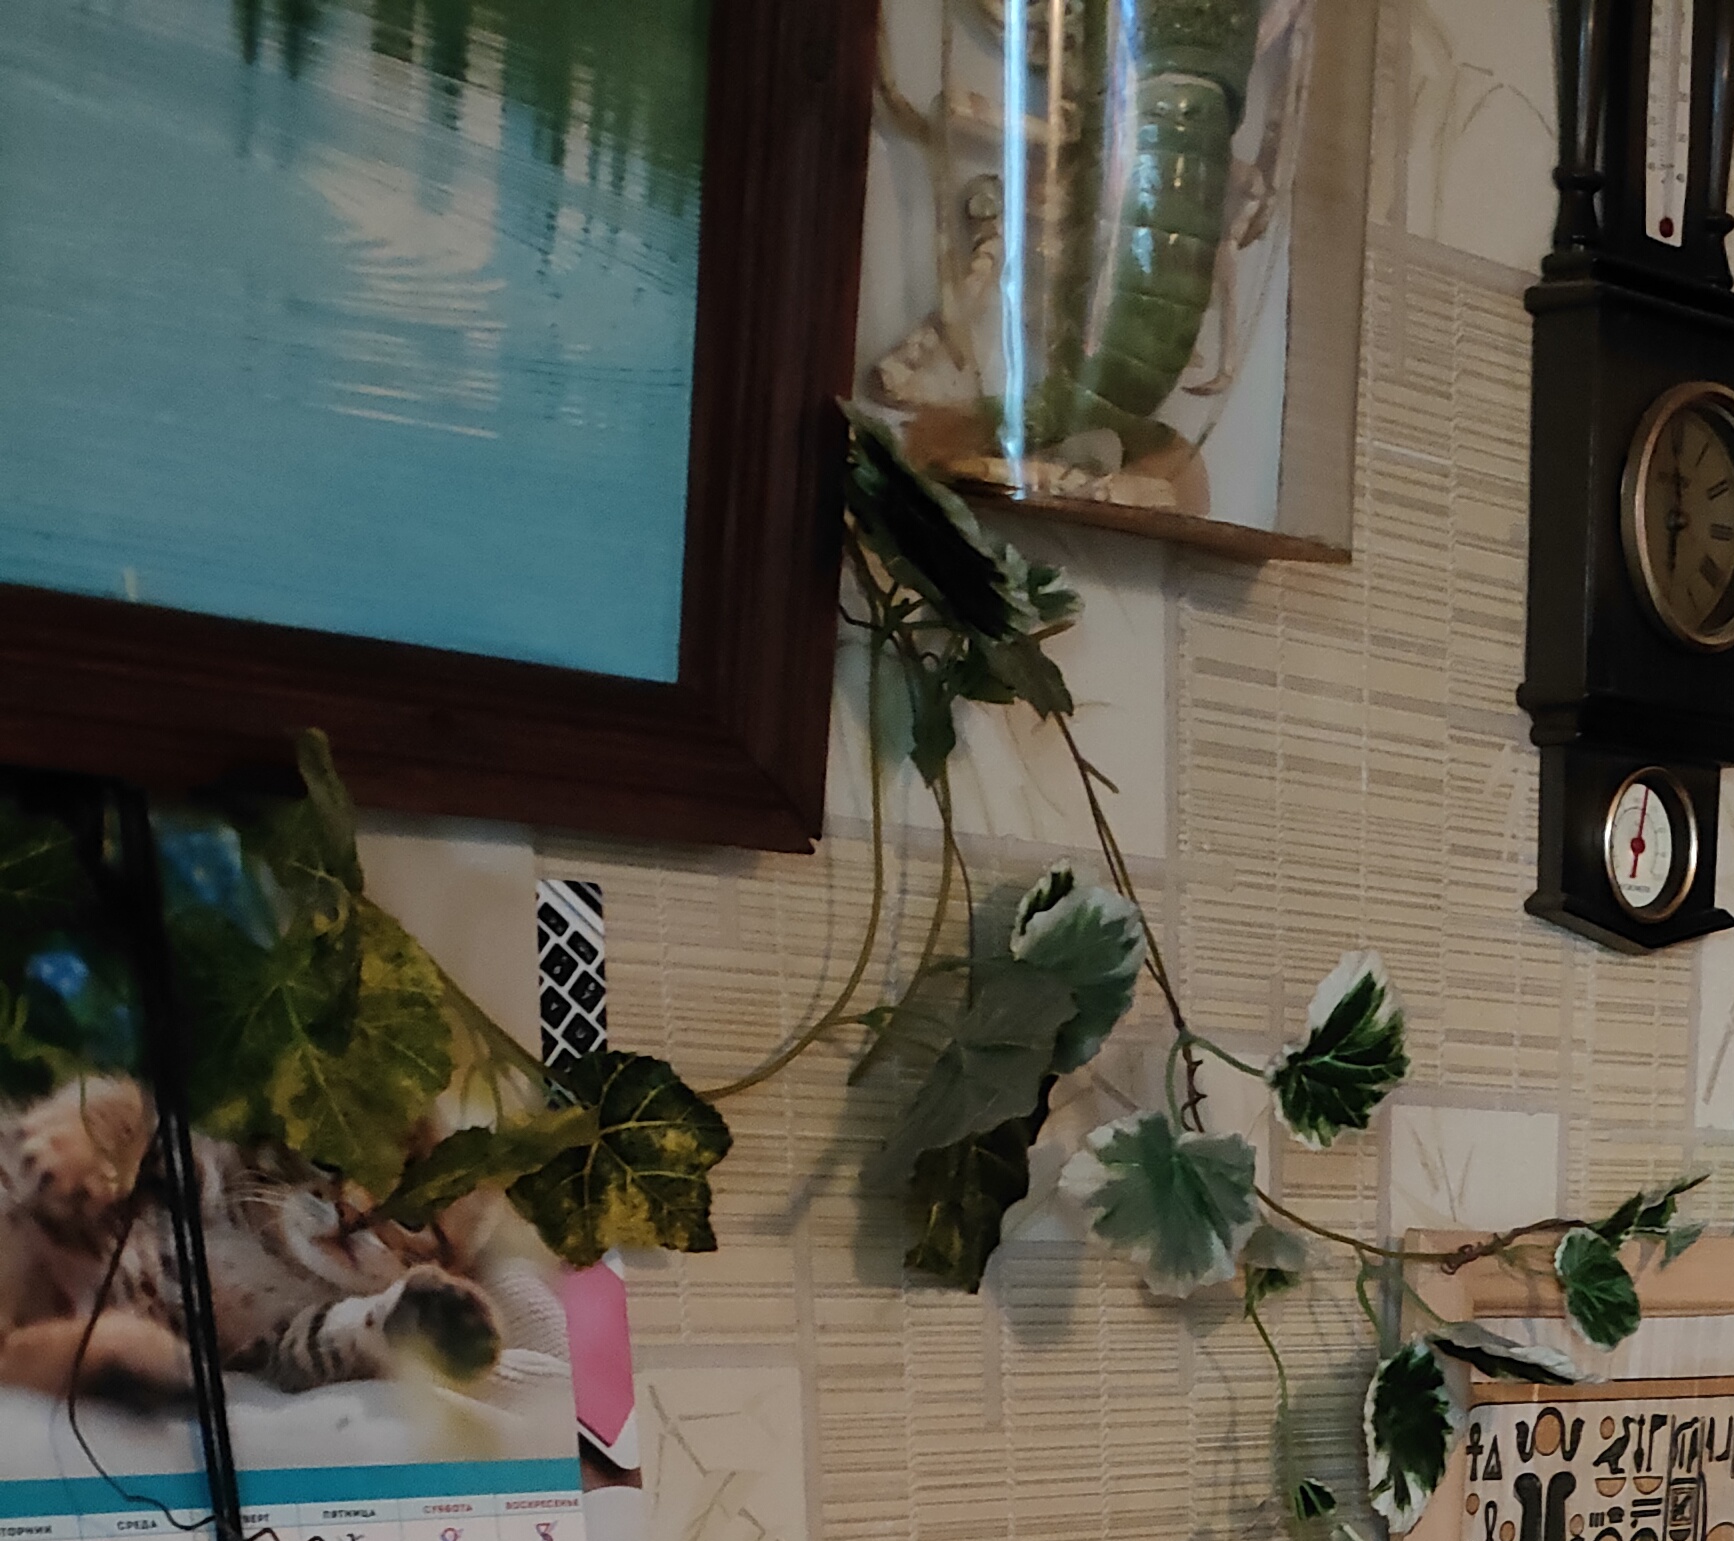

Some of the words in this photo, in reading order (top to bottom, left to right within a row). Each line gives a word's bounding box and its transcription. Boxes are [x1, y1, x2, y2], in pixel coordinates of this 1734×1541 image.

[0, 1525, 52, 1537] ТОРНИК
[116, 1519, 159, 1531] СРЕДА
[322, 1509, 376, 1519] ПЯТНИЦА
[423, 1504, 474, 1515] СУББОТА
[505, 1498, 580, 1511] ВОСКРЕСЕНЬЕ
